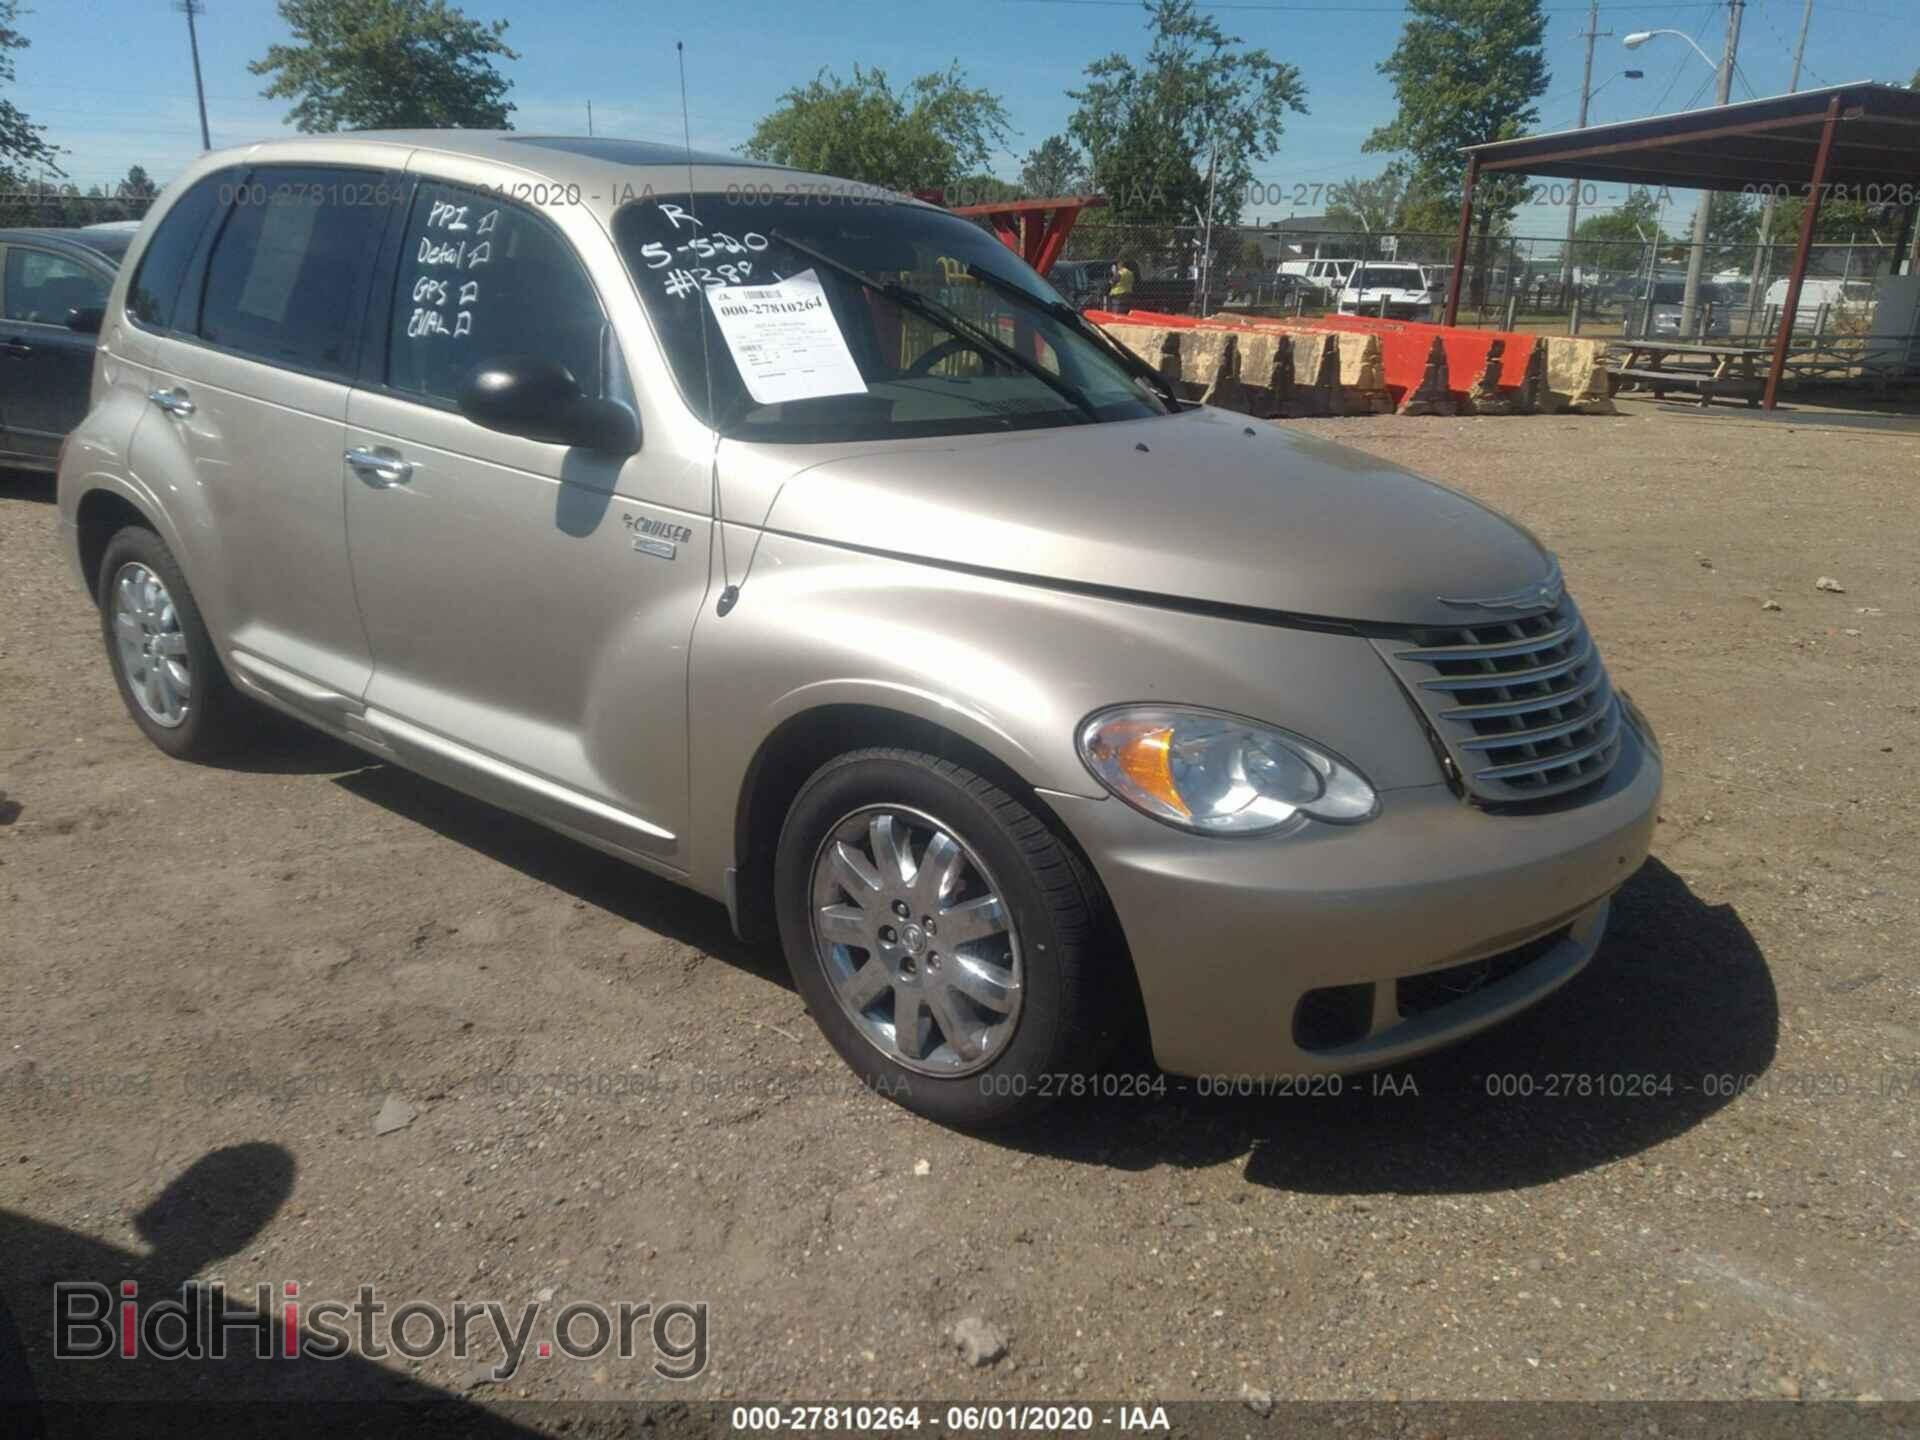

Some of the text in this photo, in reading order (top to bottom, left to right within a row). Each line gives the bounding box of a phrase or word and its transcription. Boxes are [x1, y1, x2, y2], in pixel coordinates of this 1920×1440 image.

[427, 201, 468, 230] PPI
[658, 204, 703, 229] R
[418, 236, 466, 269] Detail
[413, 276, 448, 305] GPS
[720, 296, 822, 317] 000-27810264
[634, 516, 692, 543] CRUISER
